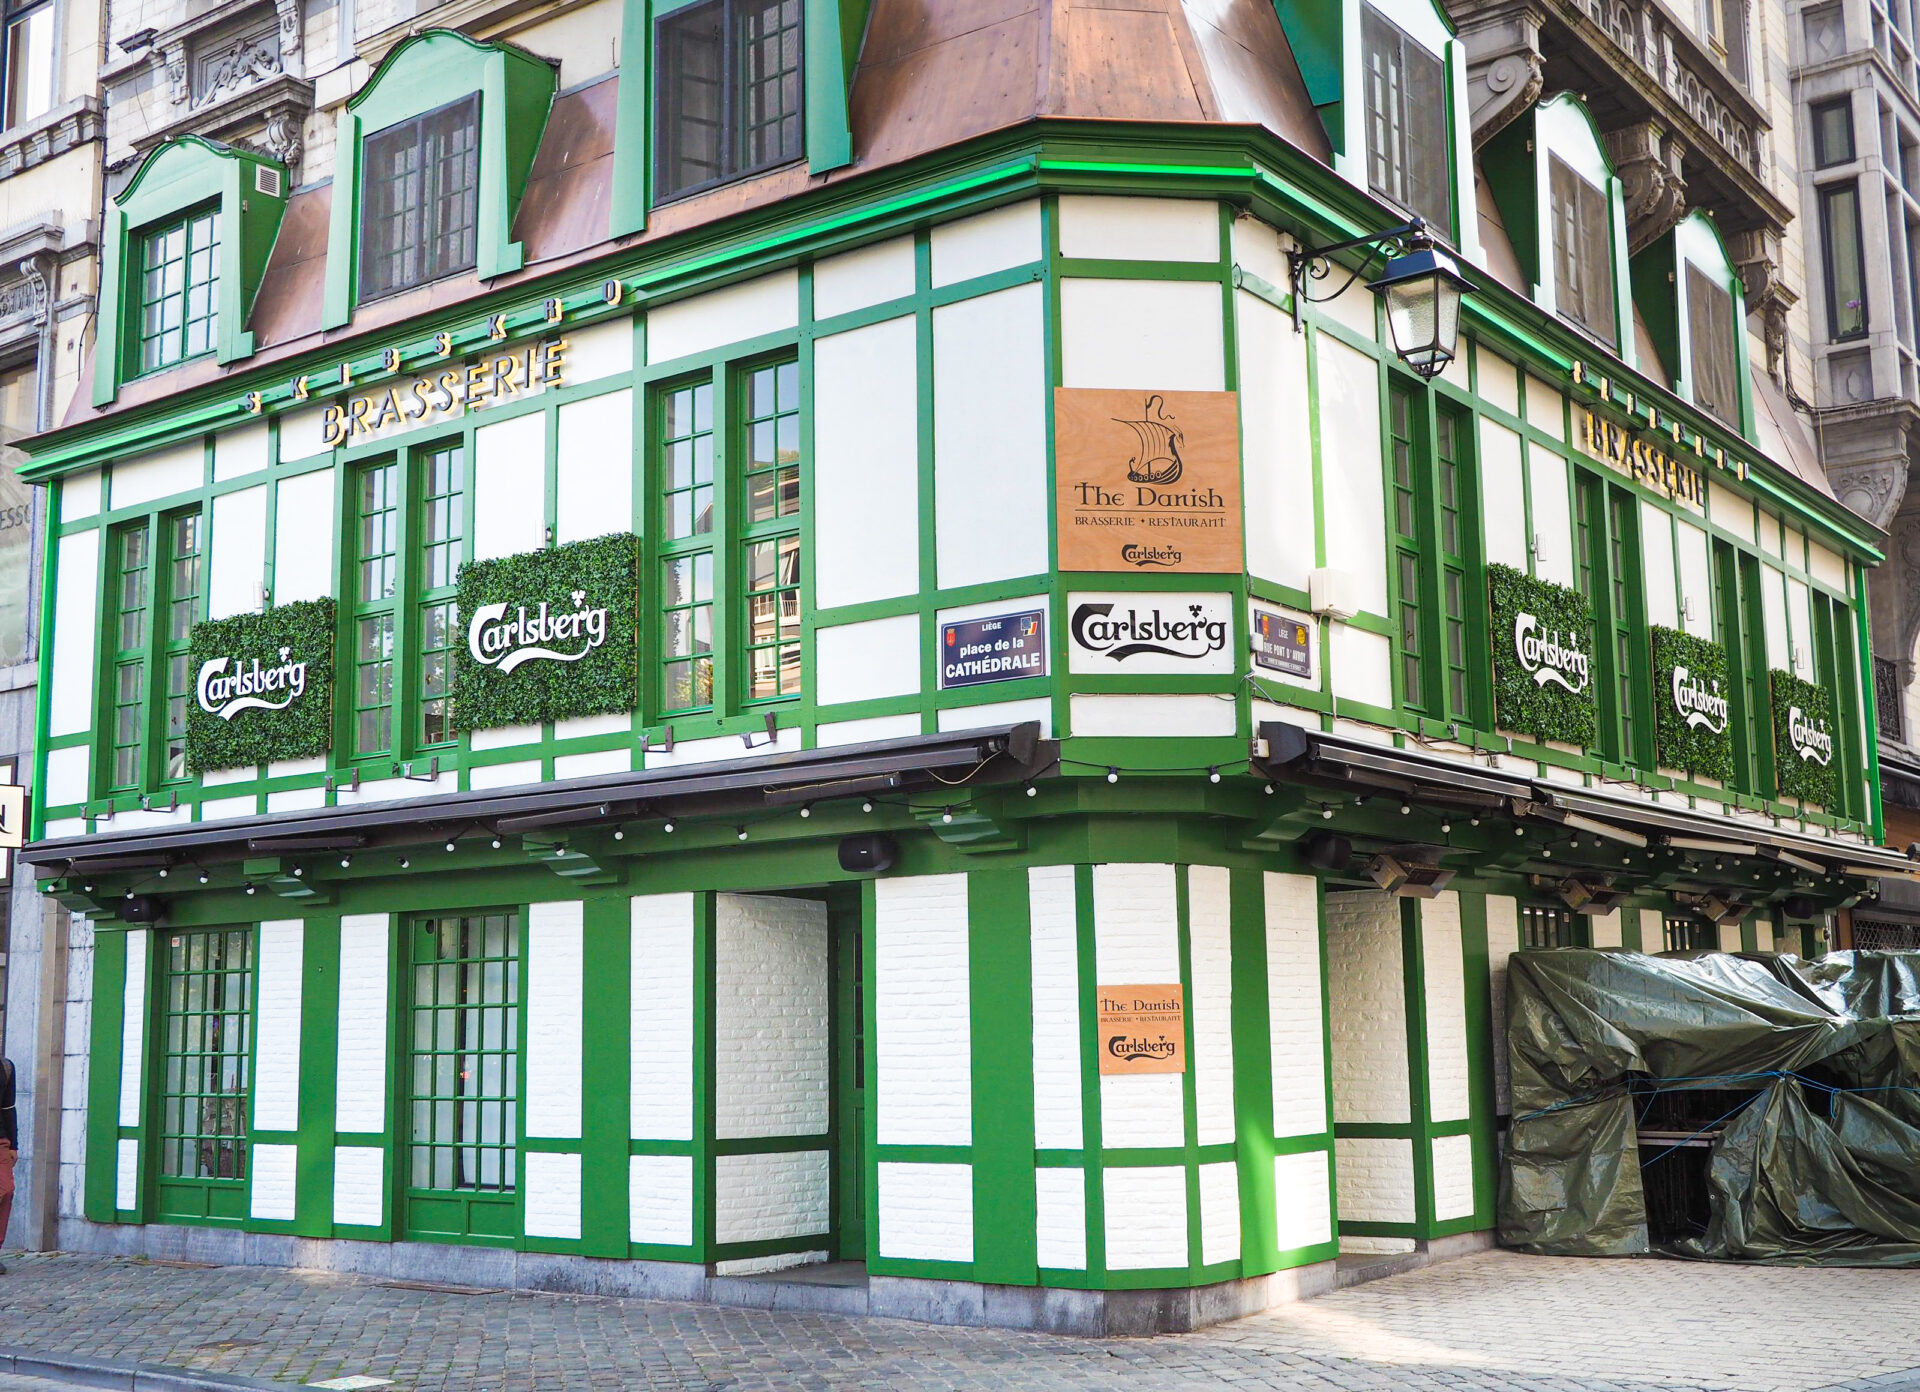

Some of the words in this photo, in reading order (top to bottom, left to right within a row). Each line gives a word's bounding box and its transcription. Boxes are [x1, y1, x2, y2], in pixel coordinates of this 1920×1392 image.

[323, 338, 567, 445] BRASSERIE
[1588, 411, 1705, 509] BRASSERIE
[1074, 482, 1125, 506] The
[1136, 486, 1225, 508] Danish
[1075, 516, 1136, 527] BRASSERIE
[1149, 516, 1227, 528] RESTAURANT
[1121, 543, 1182, 564] Carlsberg
[468, 597, 607, 667] Carlsberg
[981, 621, 1002, 632] LIÈGE
[1071, 603, 1227, 653] Carlsberg
[945, 653, 1041, 678] CATHÉDRALE
[960, 644, 993, 659] place
[995, 639, 1010, 651] de
[1012, 637, 1024, 649] la
[1515, 612, 1588, 689] Carlsberg
[195, 650, 307, 715] Carlsberg
[1673, 666, 1728, 729] Carlsberg
[1789, 706, 1832, 765] Carlsberg
[1100, 998, 1128, 1012] The
[1133, 999, 1180, 1011] Danish
[1108, 1035, 1175, 1058] Carlsberg
